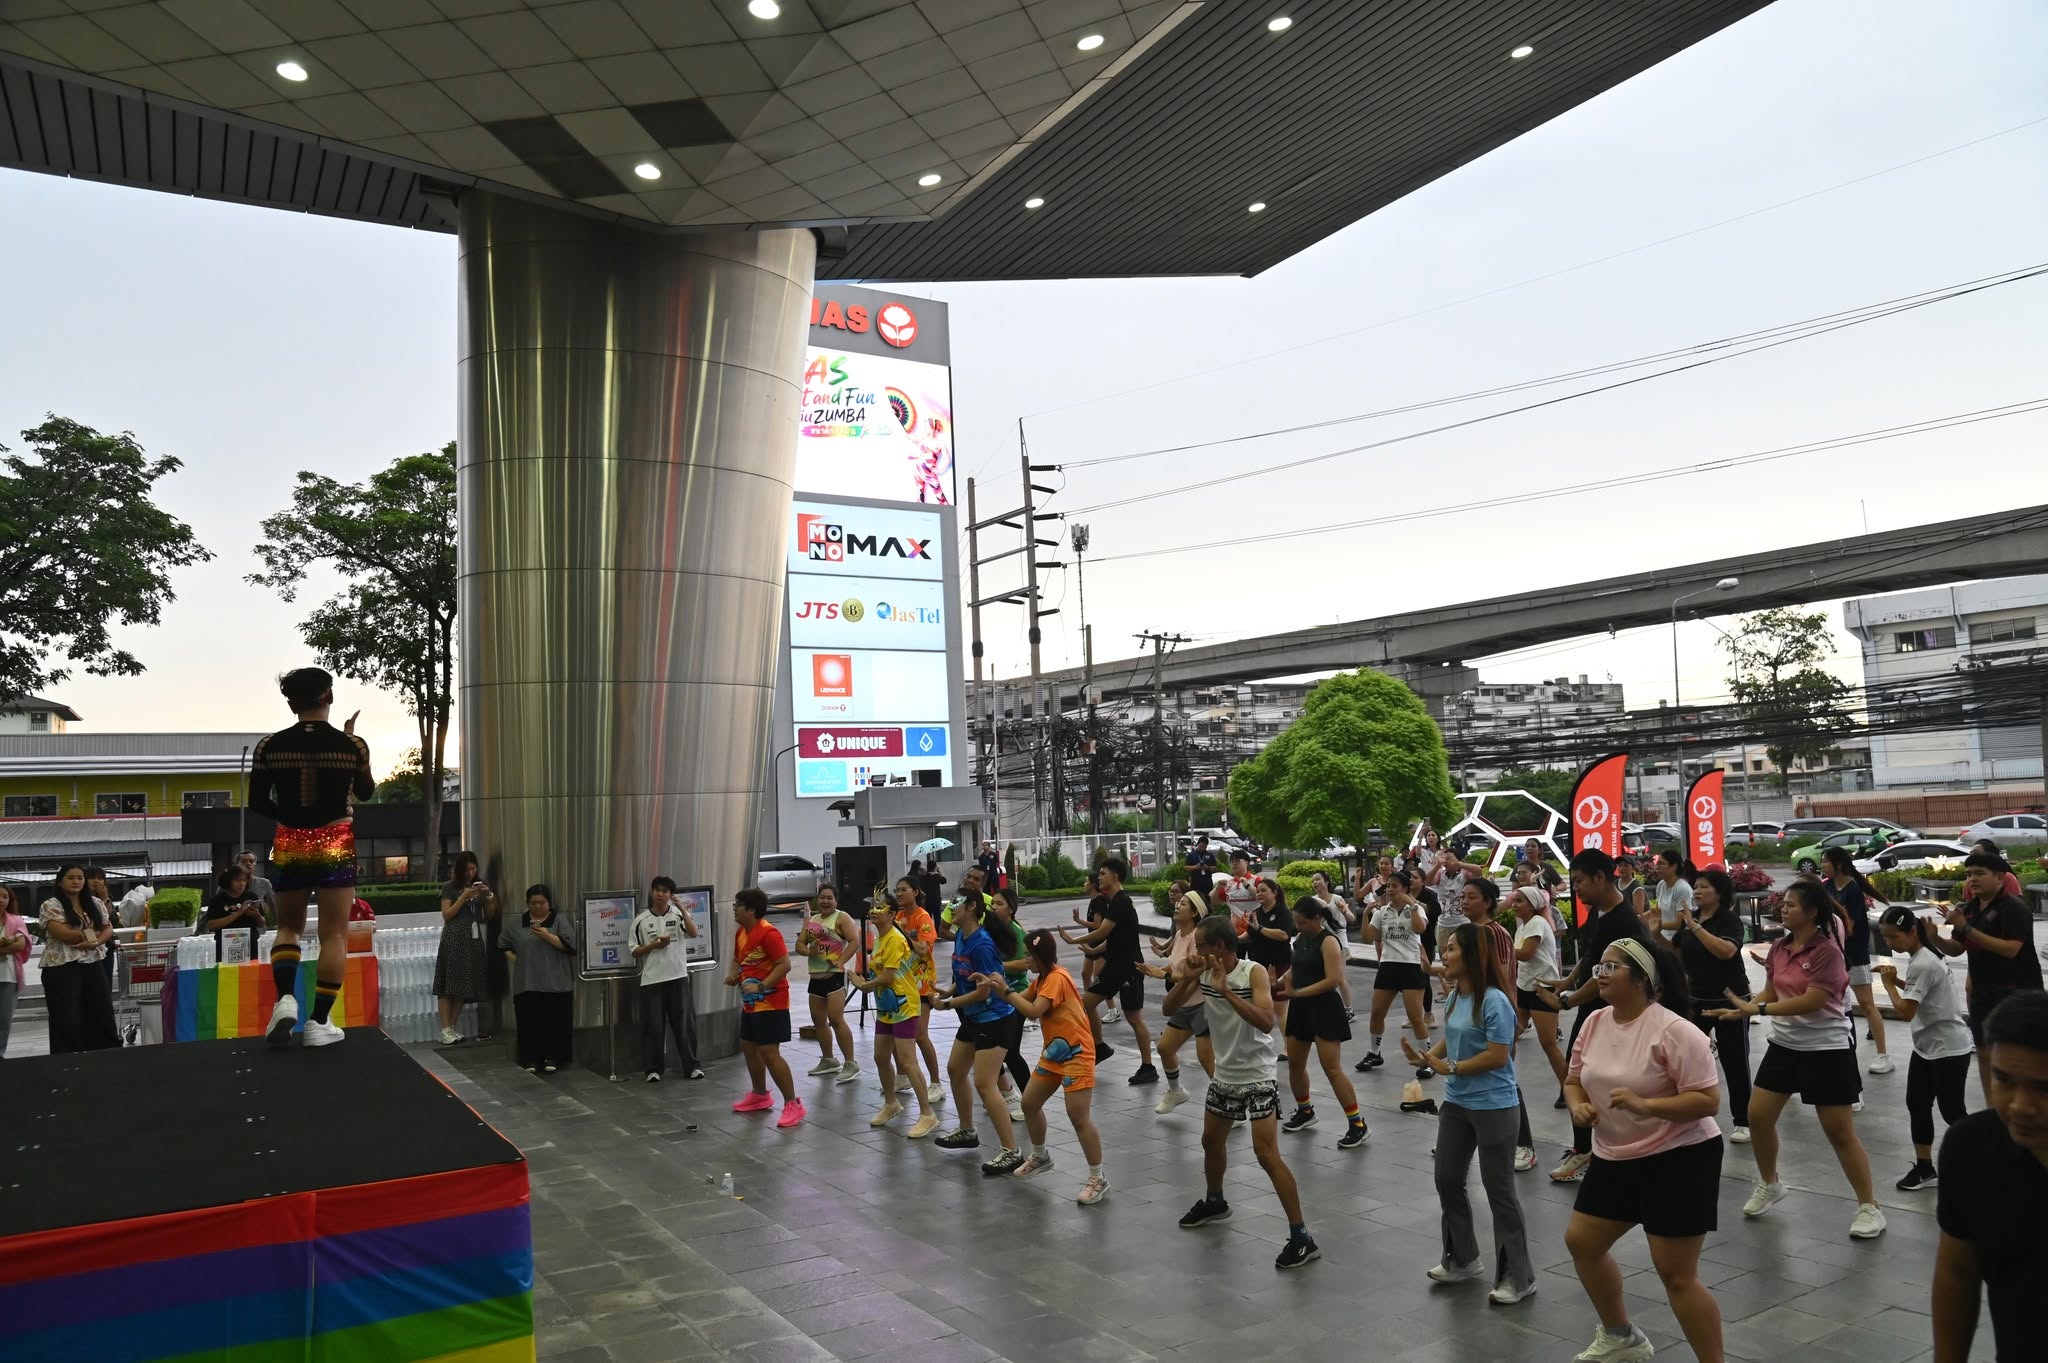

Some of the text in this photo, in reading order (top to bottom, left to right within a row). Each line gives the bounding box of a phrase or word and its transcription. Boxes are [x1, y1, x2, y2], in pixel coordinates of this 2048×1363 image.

[804, 354, 849, 386] AS
[813, 387, 842, 406] and
[845, 387, 876, 407] Fun
[814, 407, 865, 424] ZUMBA
[847, 534, 932, 560] MAX
[796, 602, 839, 619] JTS
[889, 606, 941, 624] JasTel
[837, 737, 887, 751] UNIQUE
[1698, 820, 1715, 857] JAS
